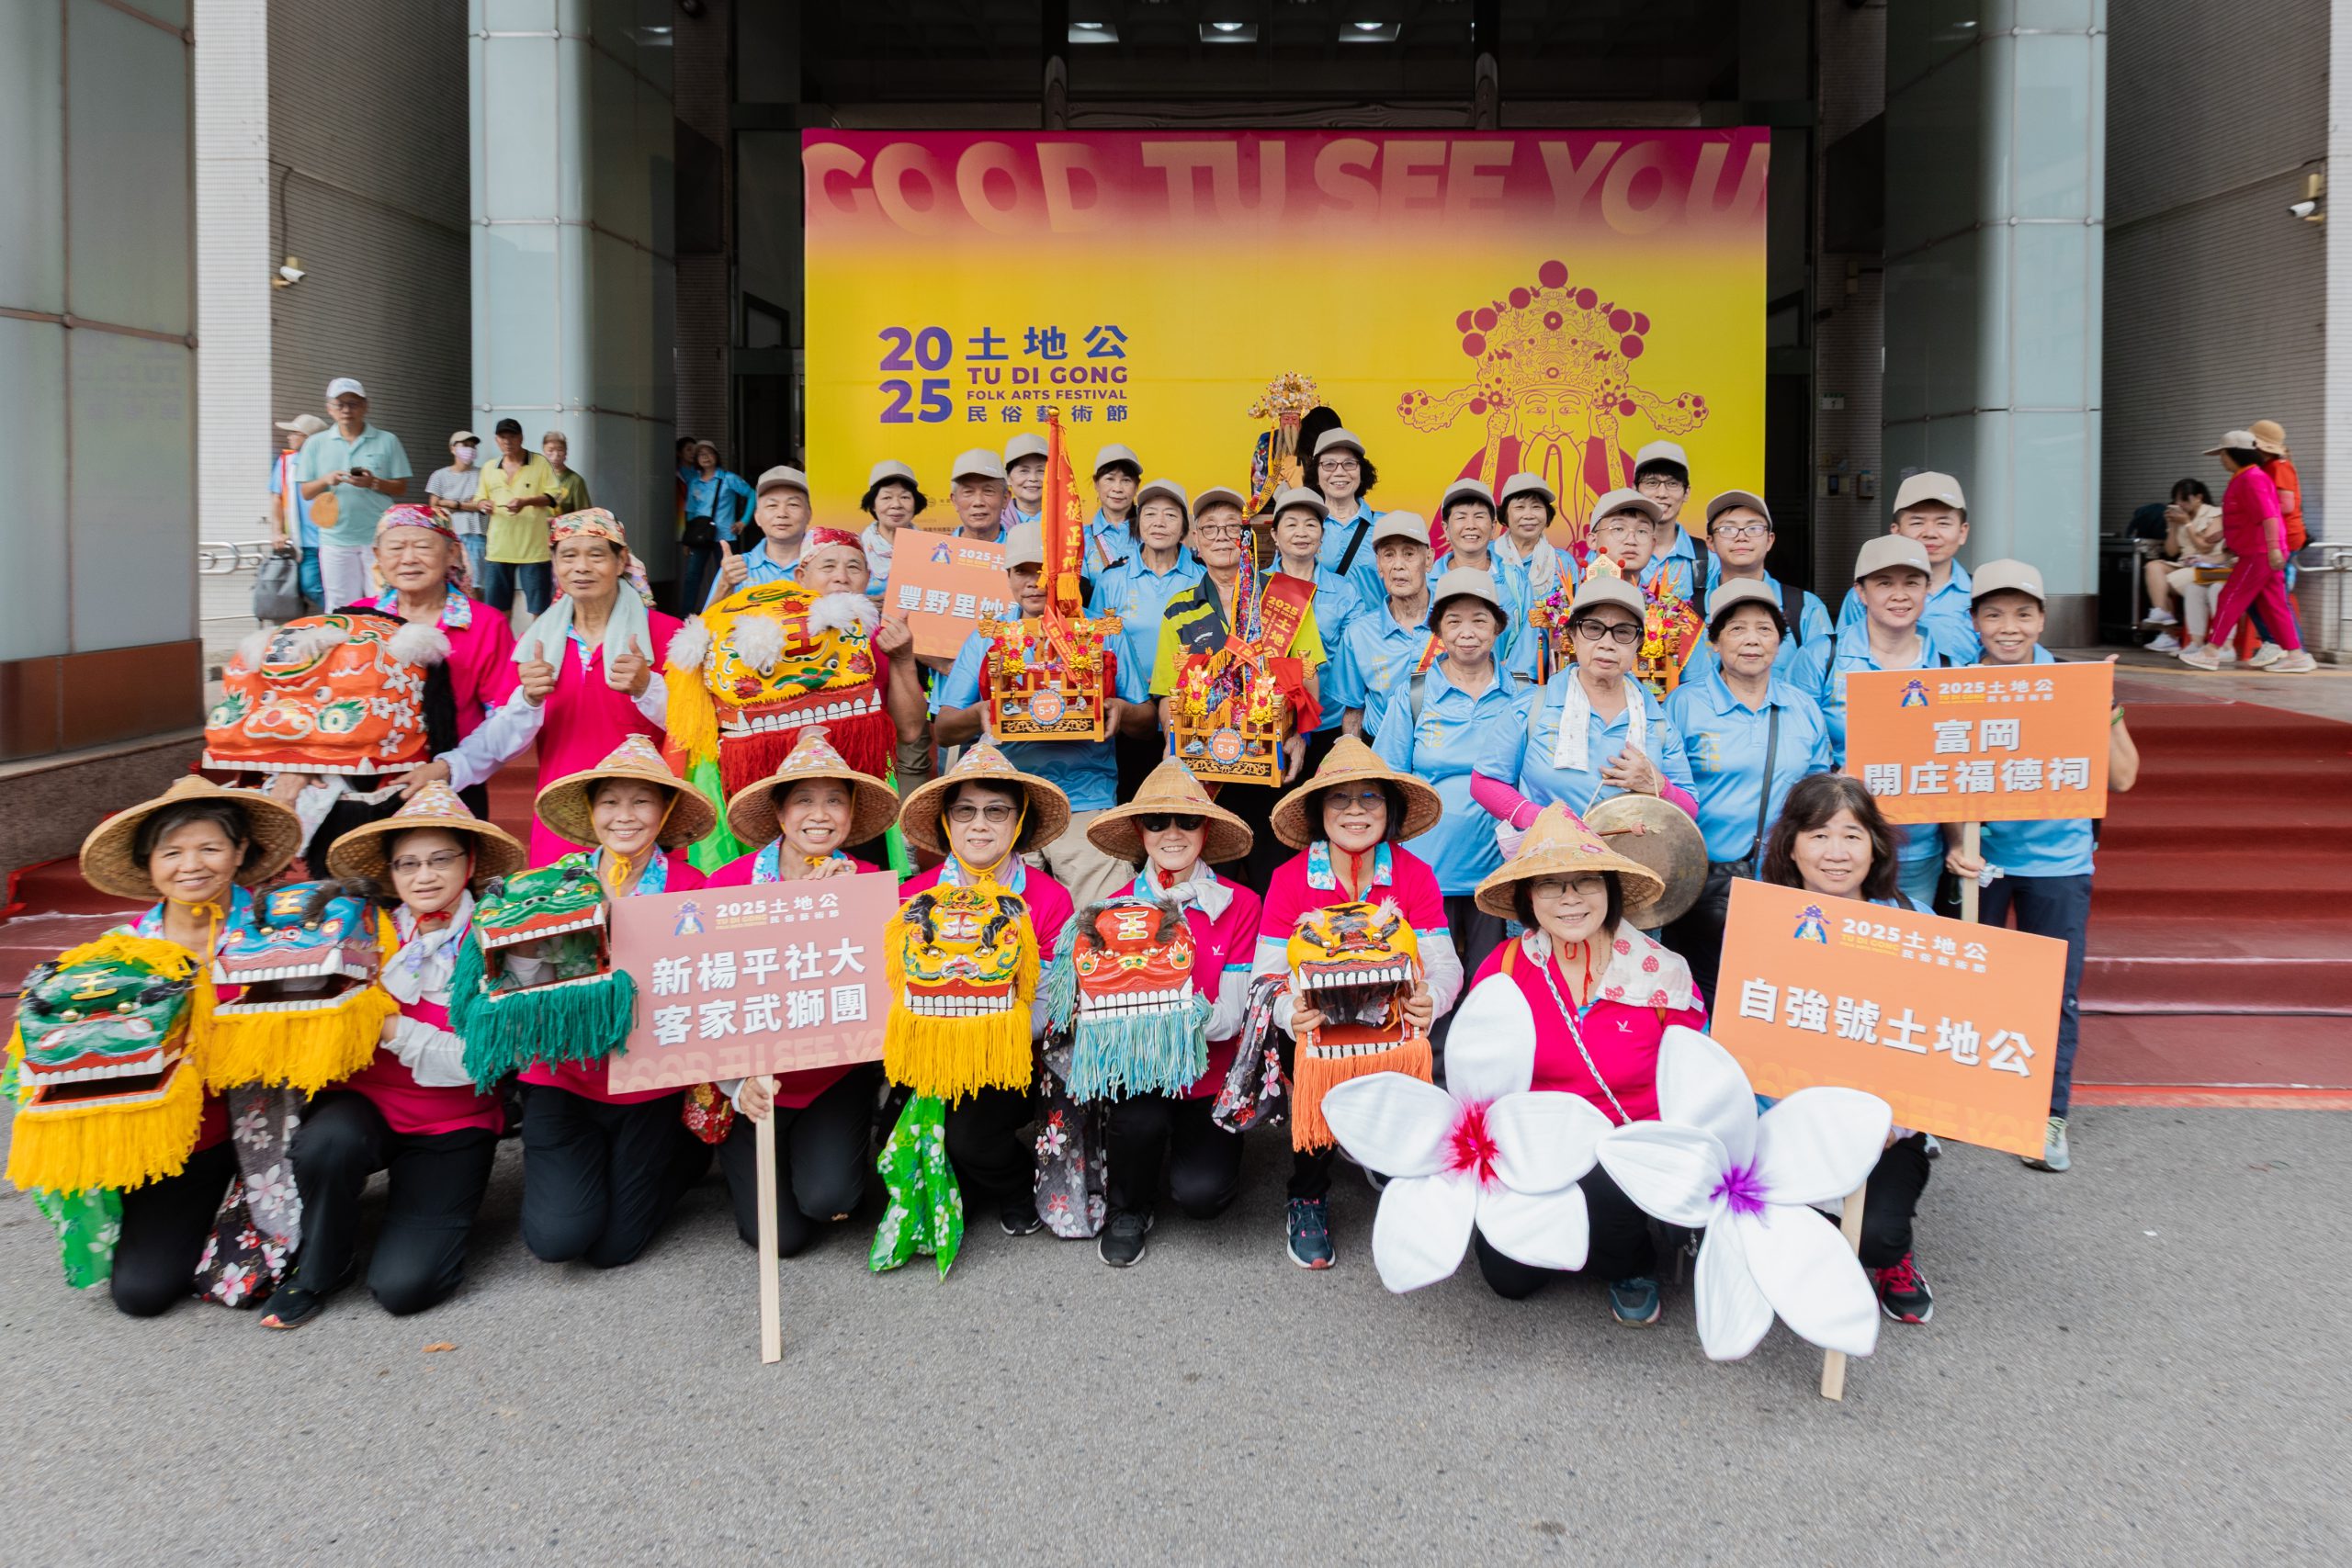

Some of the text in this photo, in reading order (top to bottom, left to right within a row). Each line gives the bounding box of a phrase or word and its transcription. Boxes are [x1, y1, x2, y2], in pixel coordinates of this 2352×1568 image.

[802, 139, 1770, 235] GOOD TU SEE YOU
[878, 326, 953, 371] 20
[966, 325, 1128, 360] 土地公
[967, 366, 1128, 385] TU DI GONG
[878, 378, 953, 423] 25
[967, 389, 1127, 400] FOLK ARTS FESTIVAL
[959, 548, 991, 561] 2025
[896, 584, 1019, 621] 豐野里妙
[1267, 596, 1299, 616] 2025
[1939, 679, 2054, 694] 2025 土地公
[1038, 705, 1056, 716] 5-9
[1217, 744, 1235, 755] 5-8
[1933, 718, 2020, 754] 富岡
[1863, 757, 2090, 796] 開庄福德祠
[716, 893, 838, 918] 2025 土地公
[1842, 918, 1901, 942] 2025
[1902, 931, 1988, 962] 土地公
[651, 937, 865, 997] 新楊平社大
[651, 983, 868, 1046] 客家武獅團
[1738, 977, 2035, 1077] 自強號土地公
